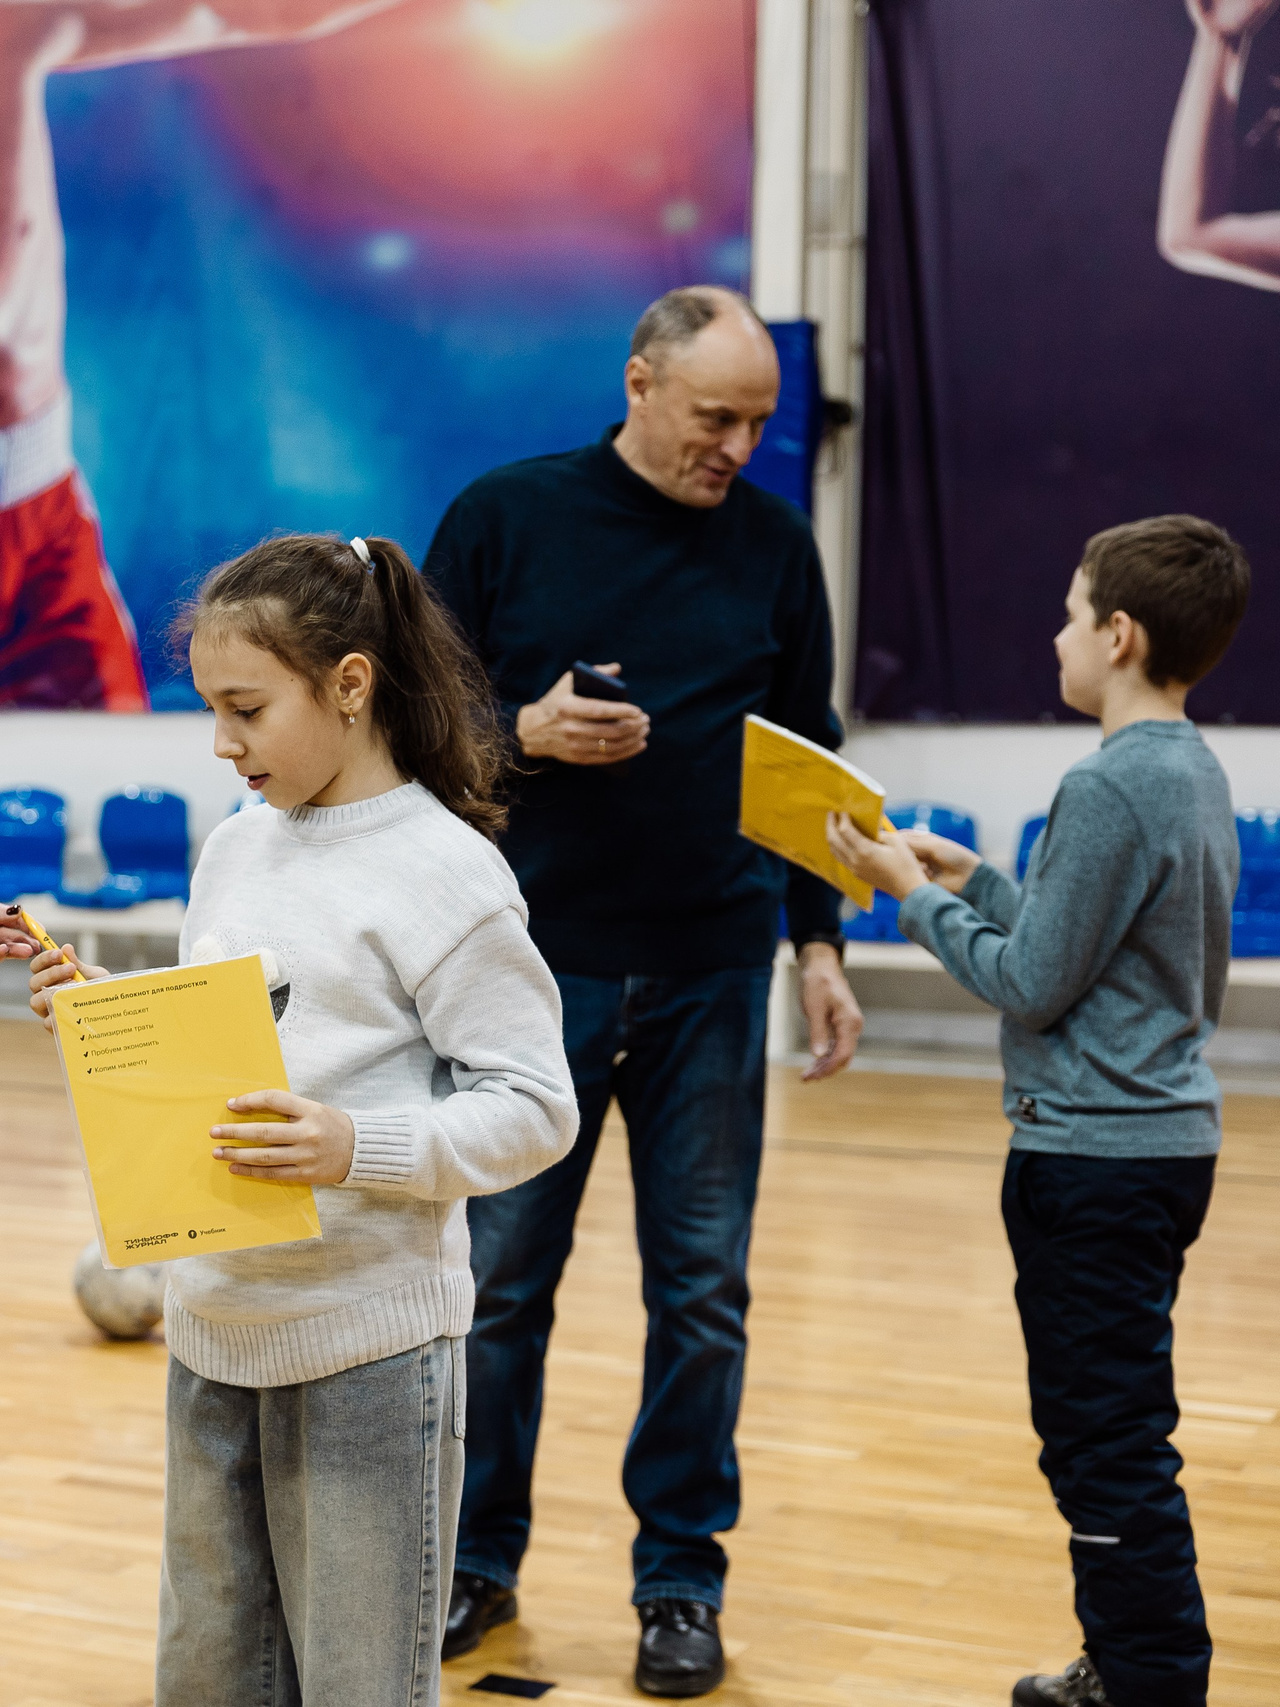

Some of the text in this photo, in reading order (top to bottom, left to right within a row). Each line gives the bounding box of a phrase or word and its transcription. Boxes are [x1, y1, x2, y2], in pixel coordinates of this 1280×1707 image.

[72, 994, 120, 1008] Финансовый
[120, 990, 150, 1000] блокнот
[165, 980, 208, 991] подростков
[84, 1007, 149, 1023] Планируем бюджет
[87, 1024, 154, 1040] Анализируем траты
[91, 1040, 160, 1057] Пробуем экономить
[94, 1065, 117, 1073] Копим
[124, 1232, 179, 1245] ТИНЬКОФФ
[200, 1228, 226, 1236] Учебник
[125, 1239, 167, 1250] ЖУРНАЛ
